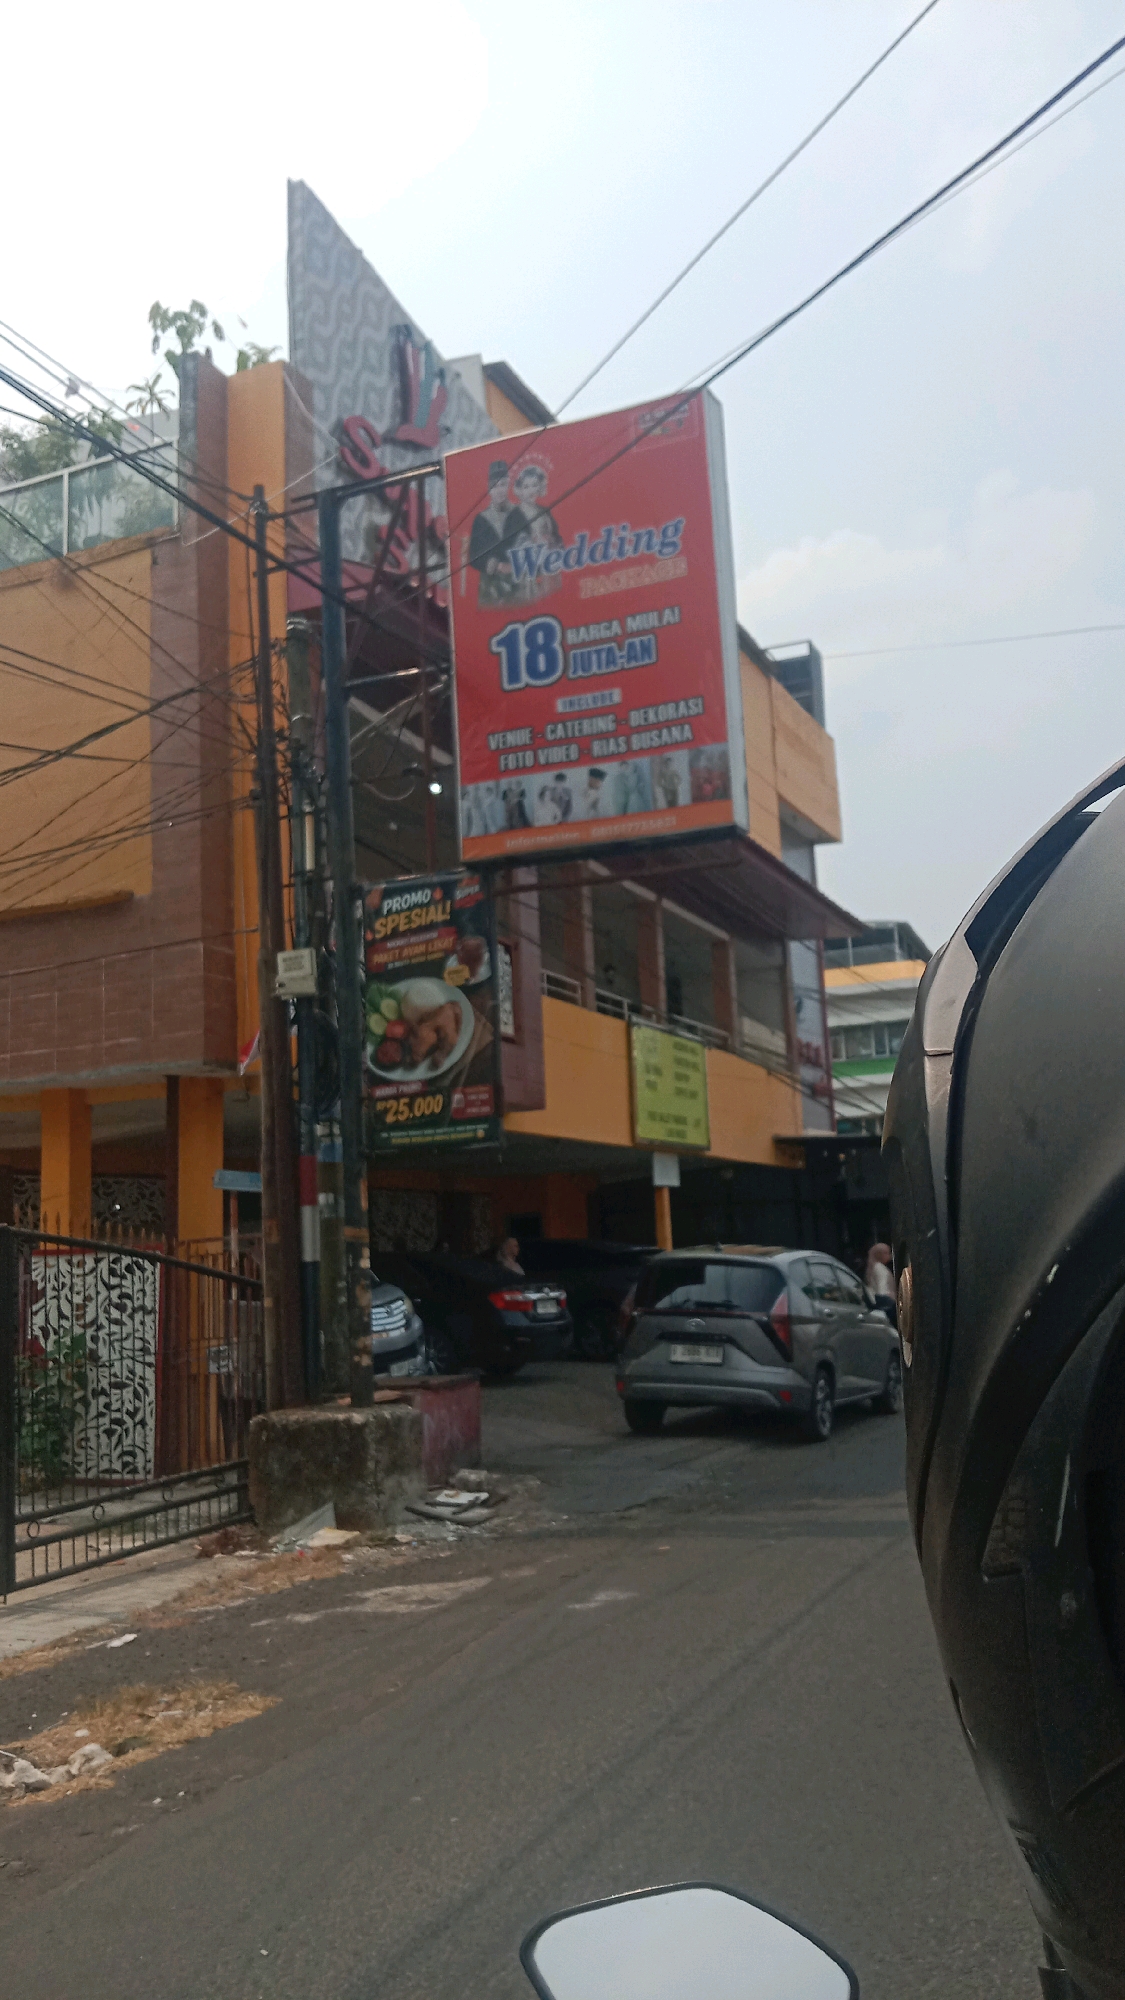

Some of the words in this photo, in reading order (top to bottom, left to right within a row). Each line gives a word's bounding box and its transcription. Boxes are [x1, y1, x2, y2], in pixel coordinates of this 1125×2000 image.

[507, 517, 685, 582] Wedding
[565, 619, 622, 645] HARGA
[625, 606, 681, 634] MULAI
[490, 615, 565, 692] 18
[567, 634, 658, 680] JUTA-AN
[488, 727, 534, 750] VENUE
[546, 713, 617, 741] CATERING
[629, 697, 704, 728] DEKORASI
[500, 751, 535, 772] FOTO
[538, 744, 579, 766] VIDEO
[592, 736, 628, 758] RIAS
[631, 724, 694, 751] BUSANA
[374, 900, 452, 940] SPESIAL!
[382, 888, 432, 916] PROMO
